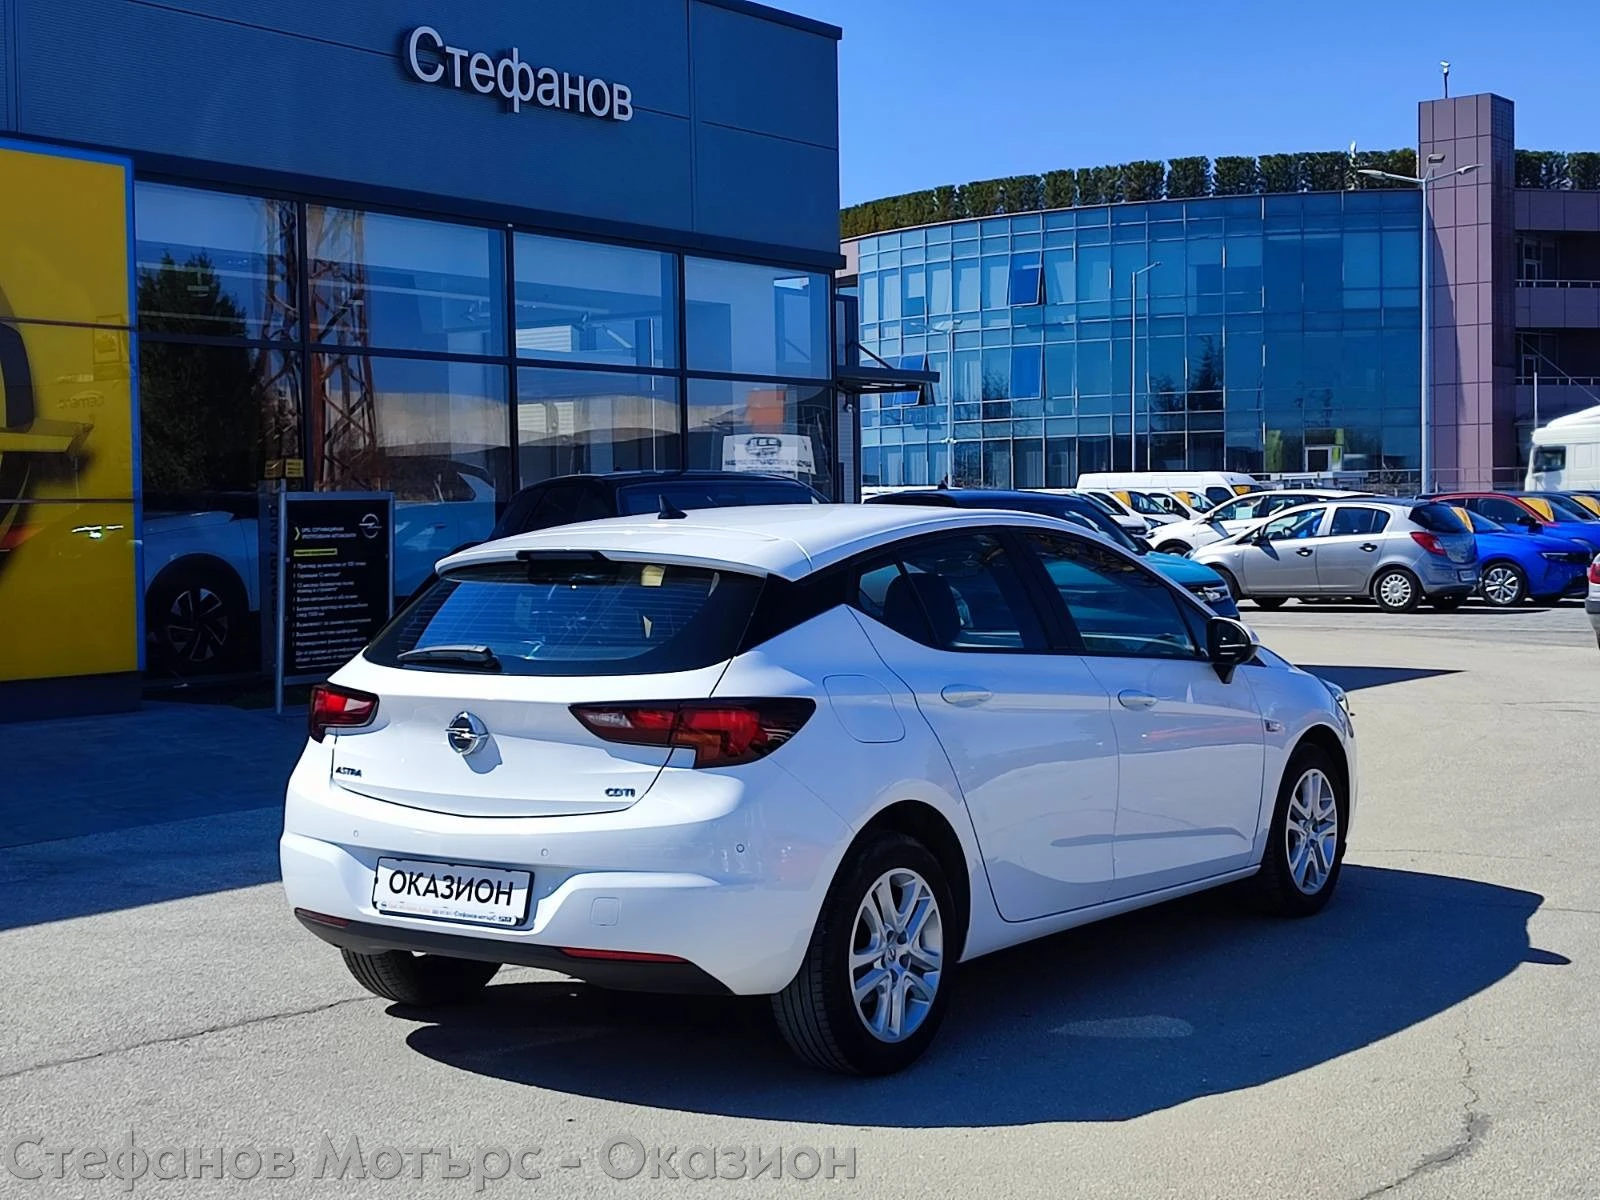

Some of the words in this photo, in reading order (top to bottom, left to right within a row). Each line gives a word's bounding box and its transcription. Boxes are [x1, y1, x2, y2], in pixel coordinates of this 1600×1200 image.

[408, 25, 634, 122] Стефанов
[335, 766, 362, 778] ASTRA
[605, 788, 635, 797] CDTI
[389, 869, 514, 906] ОКАЗИОН
